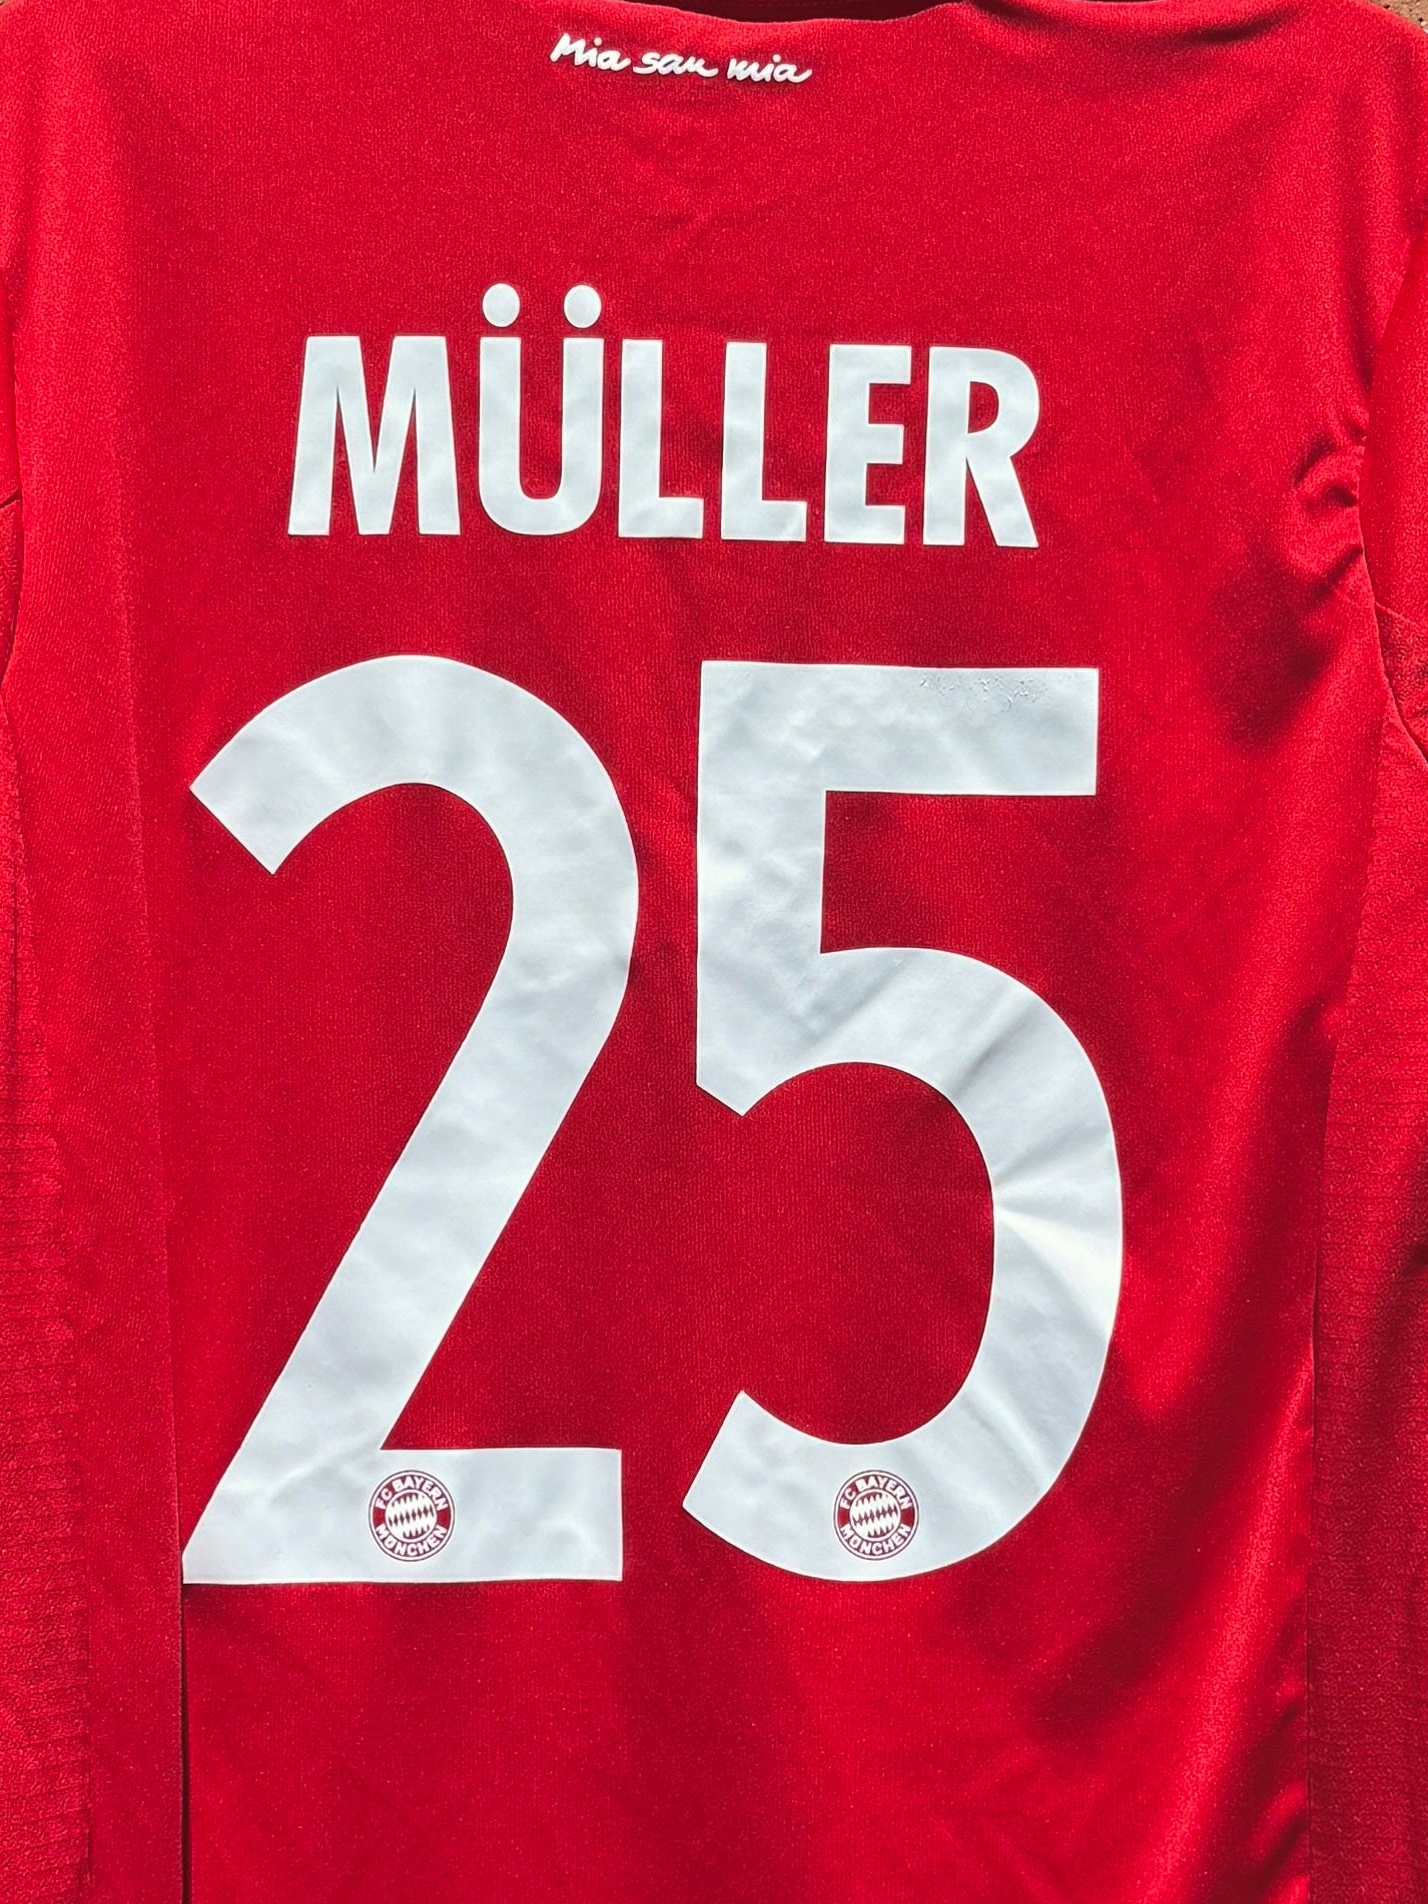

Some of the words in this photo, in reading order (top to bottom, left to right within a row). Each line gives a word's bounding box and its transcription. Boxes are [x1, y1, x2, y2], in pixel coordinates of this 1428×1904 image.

[548, 32, 632, 72] Mia
[633, 51, 719, 78] san
[726, 53, 813, 84] mia
[287, 282, 1042, 549] MÜLLER
[180, 653, 1126, 1587] 25
[377, 1490, 392, 1510] FC
[392, 1476, 448, 1511] BAYERN
[840, 1489, 856, 1510] FC
[855, 1476, 912, 1510] BAYERN
